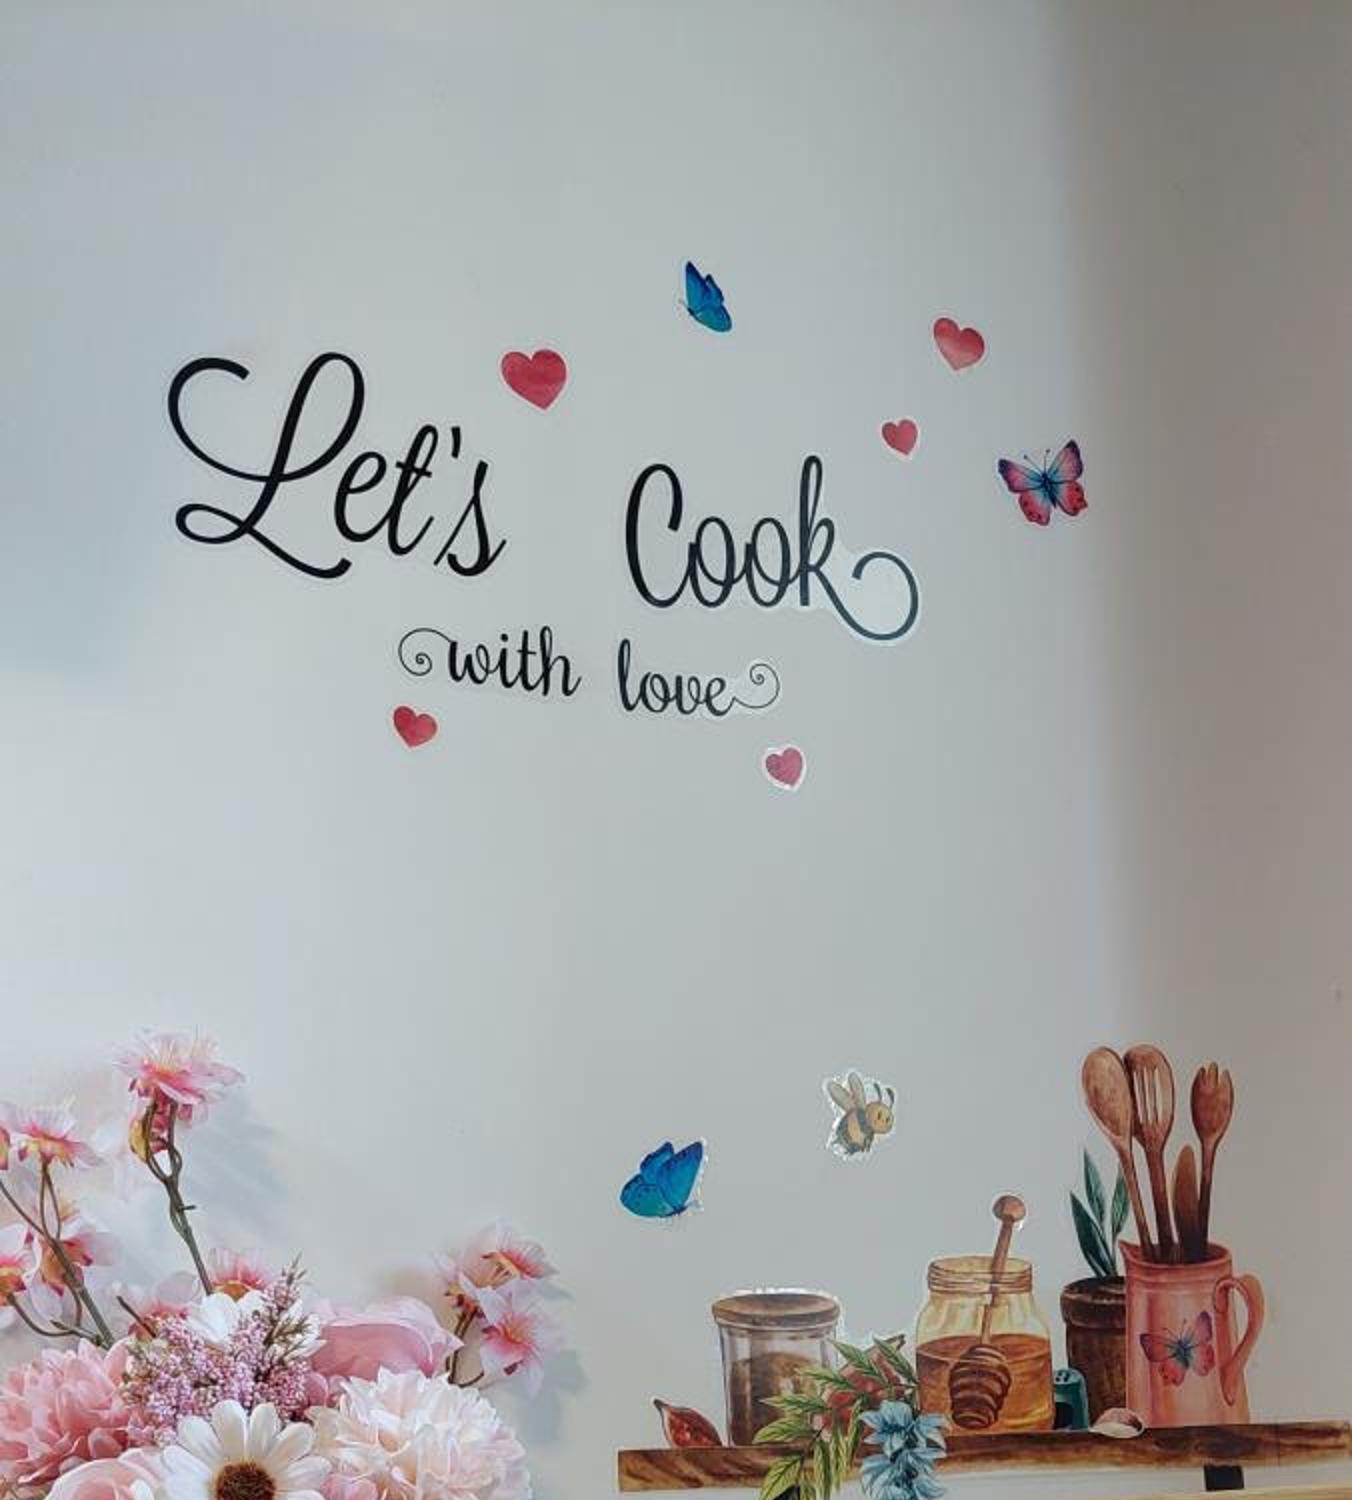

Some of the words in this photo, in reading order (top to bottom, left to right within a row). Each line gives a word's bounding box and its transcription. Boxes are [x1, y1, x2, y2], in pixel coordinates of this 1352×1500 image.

[167, 352, 507, 579] Let's
[625, 455, 919, 641] Cook
[399, 626, 582, 697] with
[617, 638, 780, 717] love
